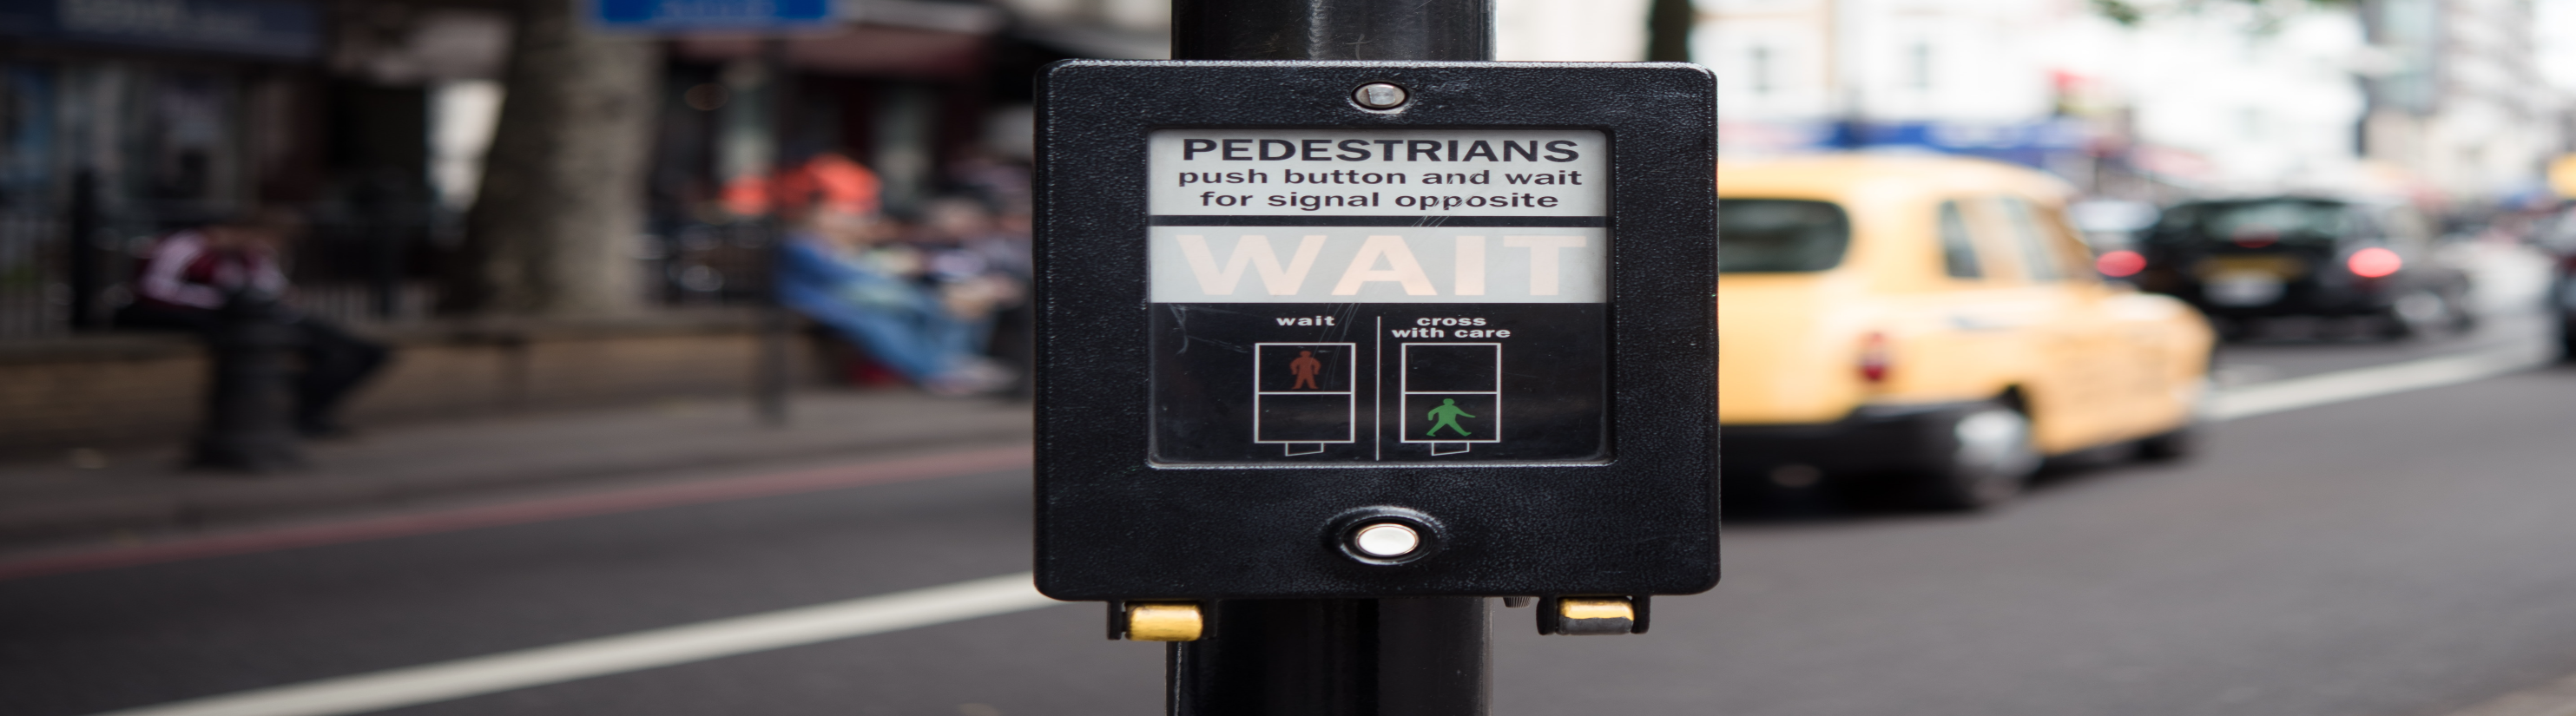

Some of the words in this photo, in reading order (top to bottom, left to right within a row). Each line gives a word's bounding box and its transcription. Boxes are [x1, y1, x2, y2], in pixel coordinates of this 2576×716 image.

[1183, 139, 1579, 162] PEDESTRIANS
[1178, 169, 1268, 187] push
[1284, 169, 1406, 185] button
[1422, 169, 1490, 185] and
[1505, 170, 1583, 186] wait
[1200, 191, 1253, 207] for
[1268, 192, 1380, 211] signal
[1395, 193, 1558, 211] opposite
[1176, 234, 1587, 296] WAIT
[1276, 315, 1335, 326] wait
[1416, 317, 1486, 326] cross
[1392, 327, 1445, 338] with
[1454, 329, 1511, 338] care
